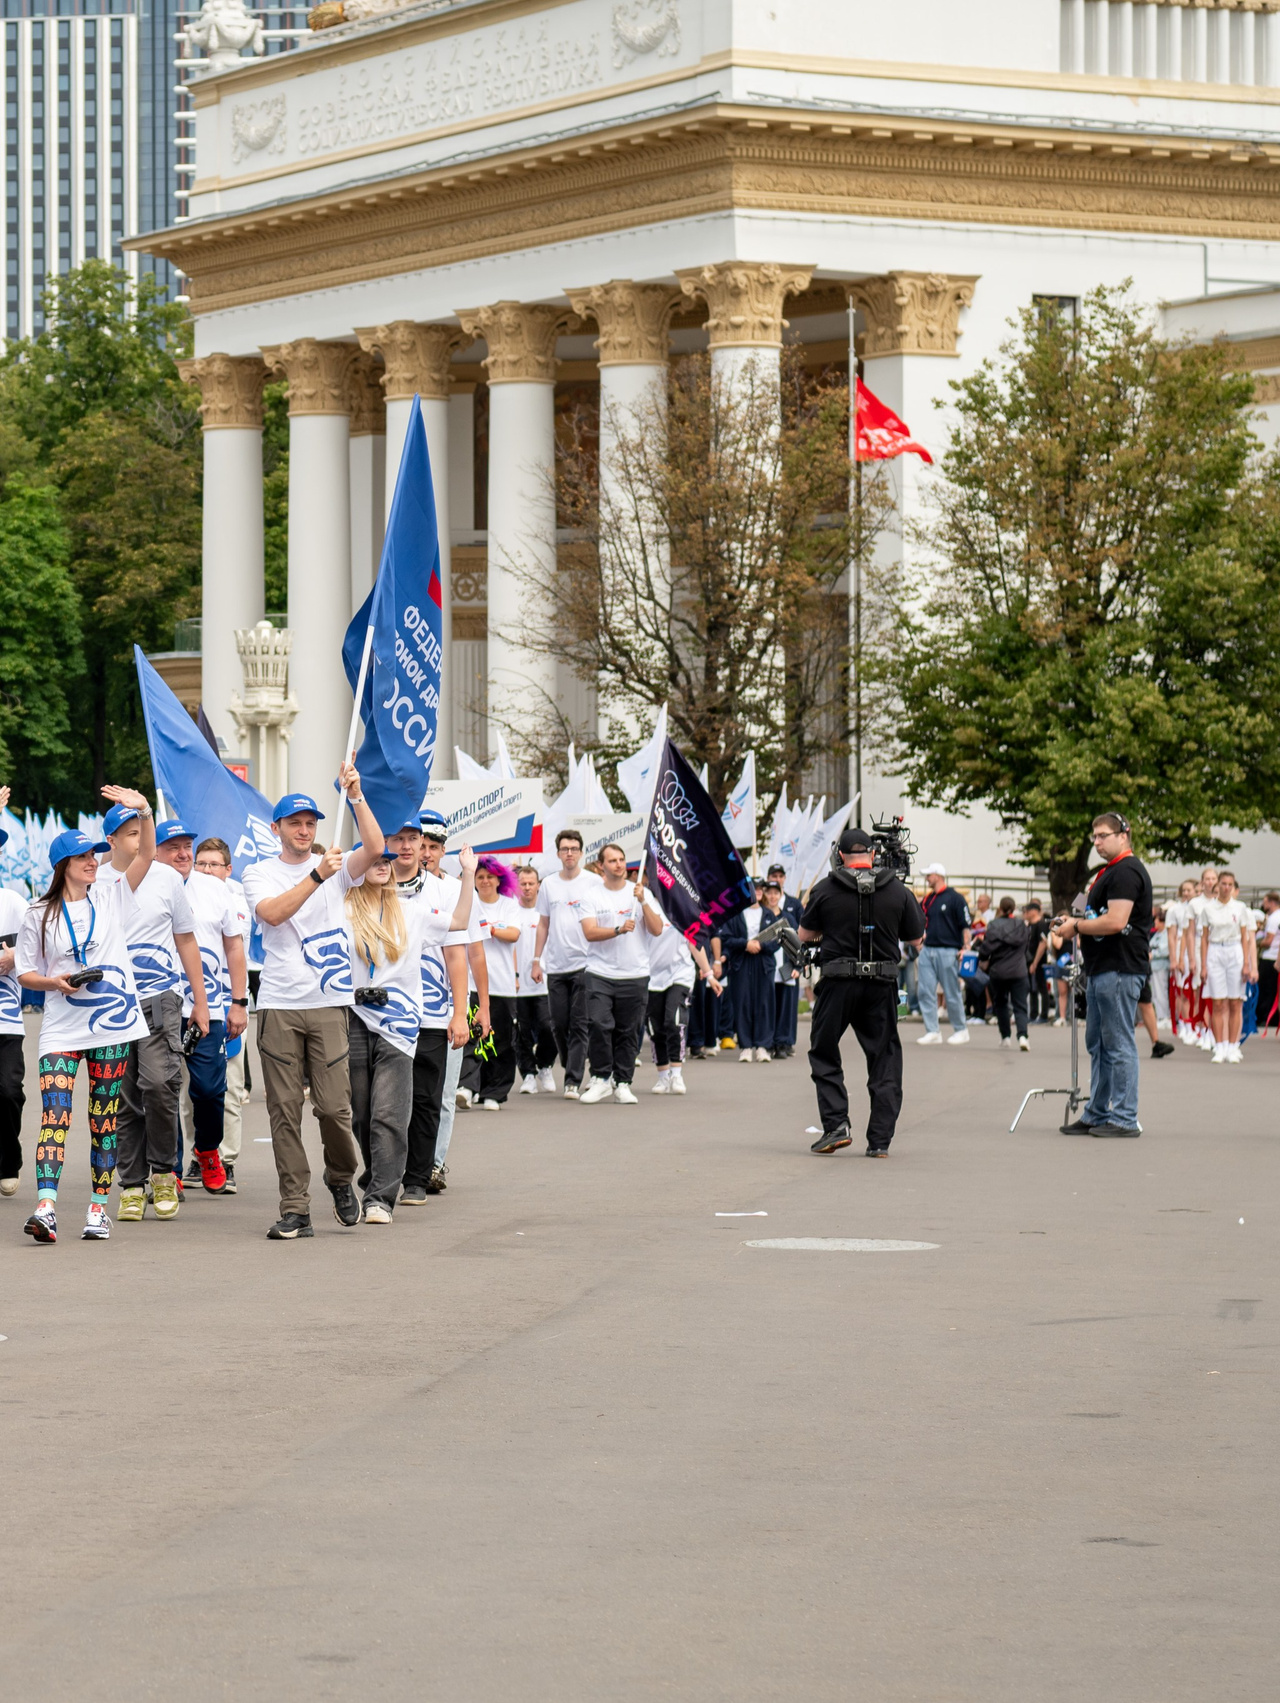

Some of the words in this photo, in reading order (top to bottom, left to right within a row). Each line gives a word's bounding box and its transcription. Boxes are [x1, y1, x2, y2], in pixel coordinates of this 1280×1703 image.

[395, 629, 427, 690] ОНОК
[444, 802, 475, 827] ЖИТАЛ
[478, 786, 504, 810] СПОРТ
[586, 817, 644, 854] КОМПЬЮТЕРНЫЙ
[656, 862, 673, 887] ОРТА
